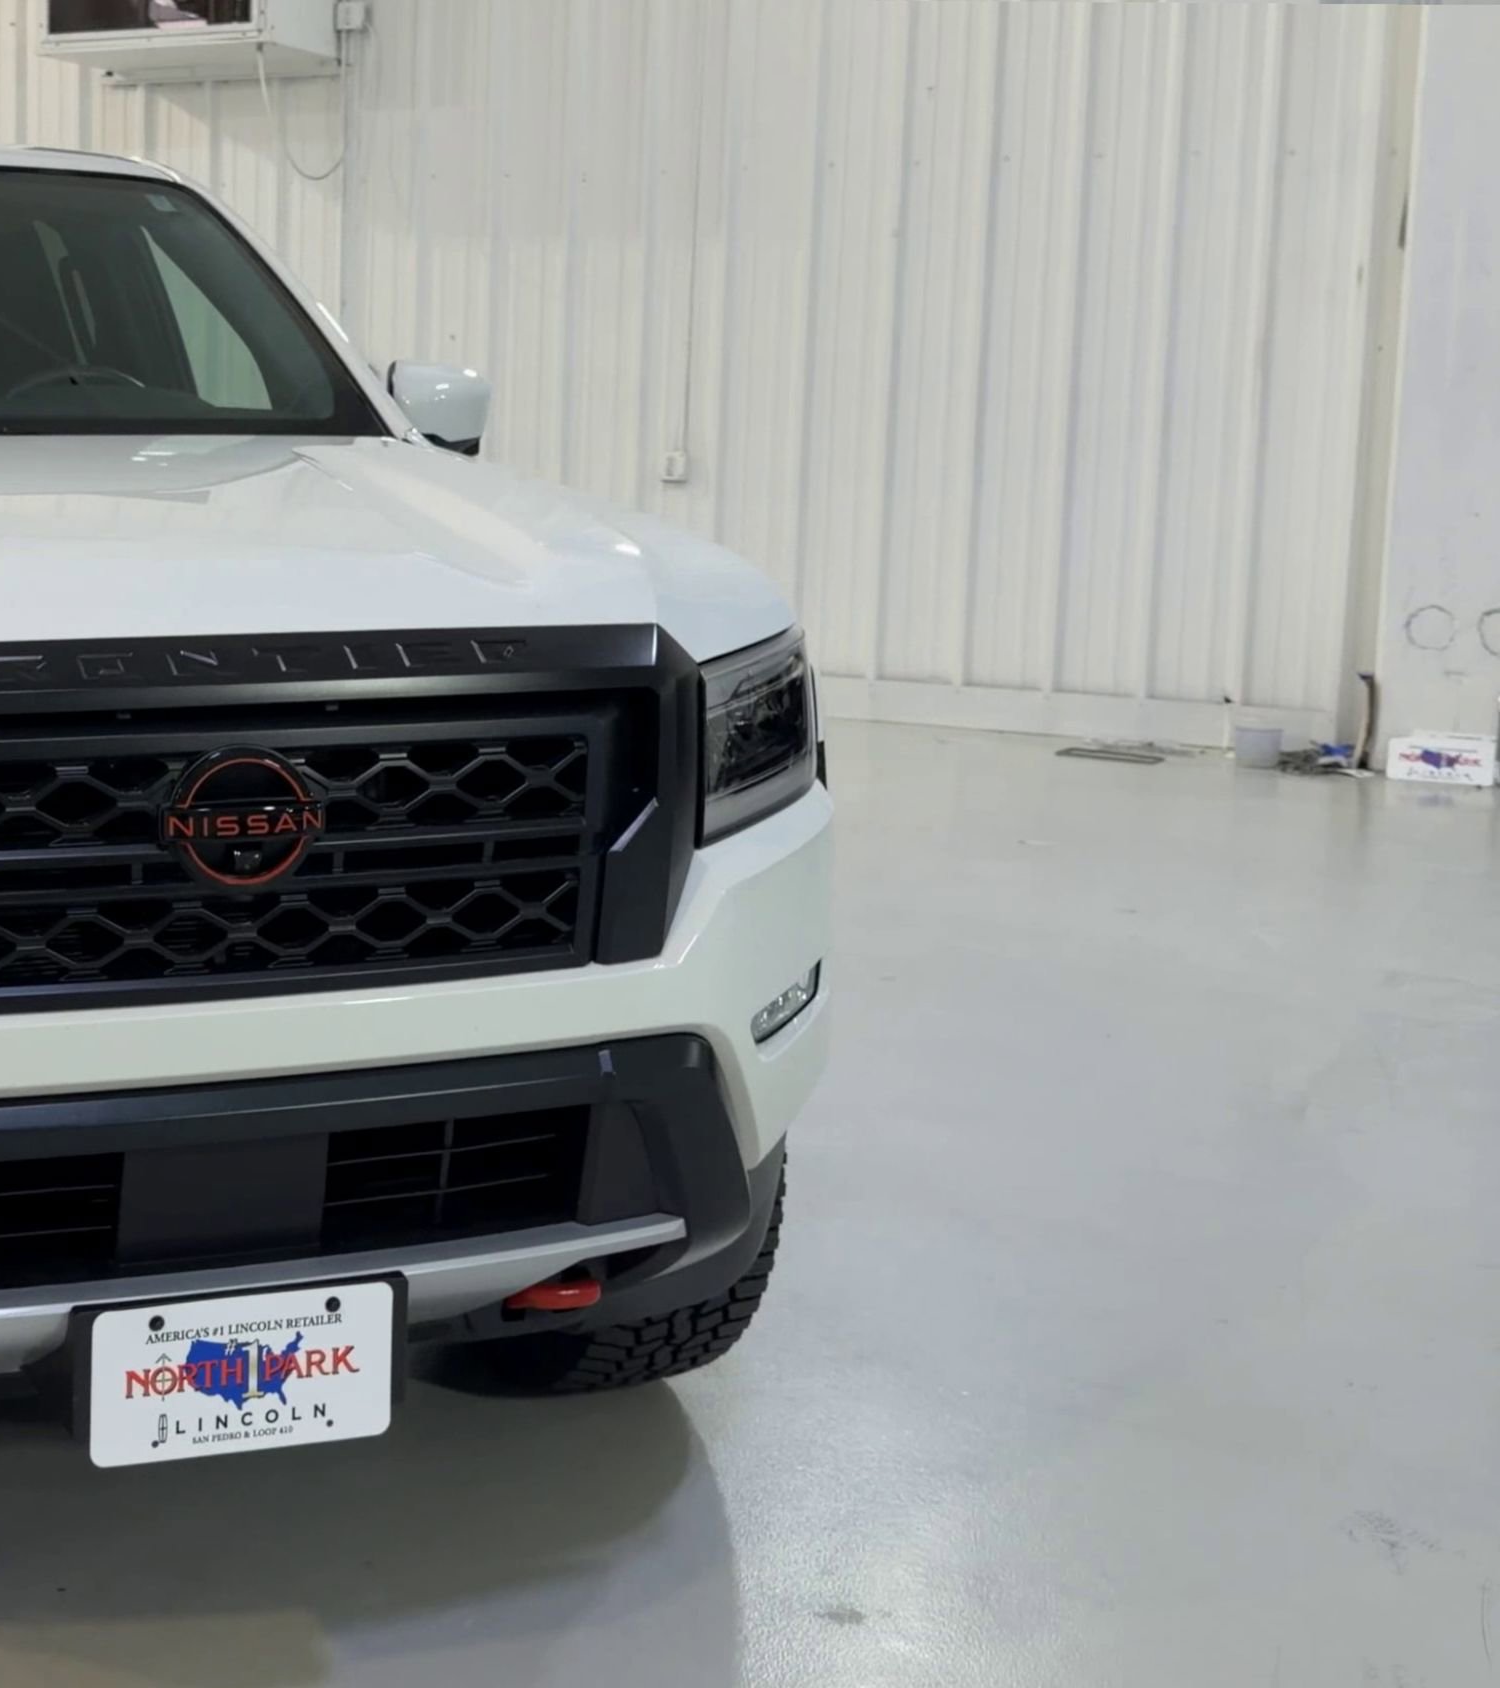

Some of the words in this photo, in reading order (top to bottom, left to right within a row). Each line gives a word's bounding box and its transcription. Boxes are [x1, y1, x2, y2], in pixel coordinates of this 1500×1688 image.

[168, 809, 322, 837] NISSAN
[145, 1325, 210, 1345] AMERICA'S
[212, 1325, 225, 1337] #1
[228, 1320, 283, 1336] LINCOLN
[286, 1313, 343, 1329] RETAILER
[125, 1357, 244, 1399] NORTH
[264, 1345, 360, 1382] PARK
[175, 1403, 327, 1434] LINCOLN
[192, 1433, 210, 1444] SAN
[211, 1431, 242, 1443] PEDRO
[243, 1430, 251, 1439] &
[252, 1427, 277, 1437] LOOP
